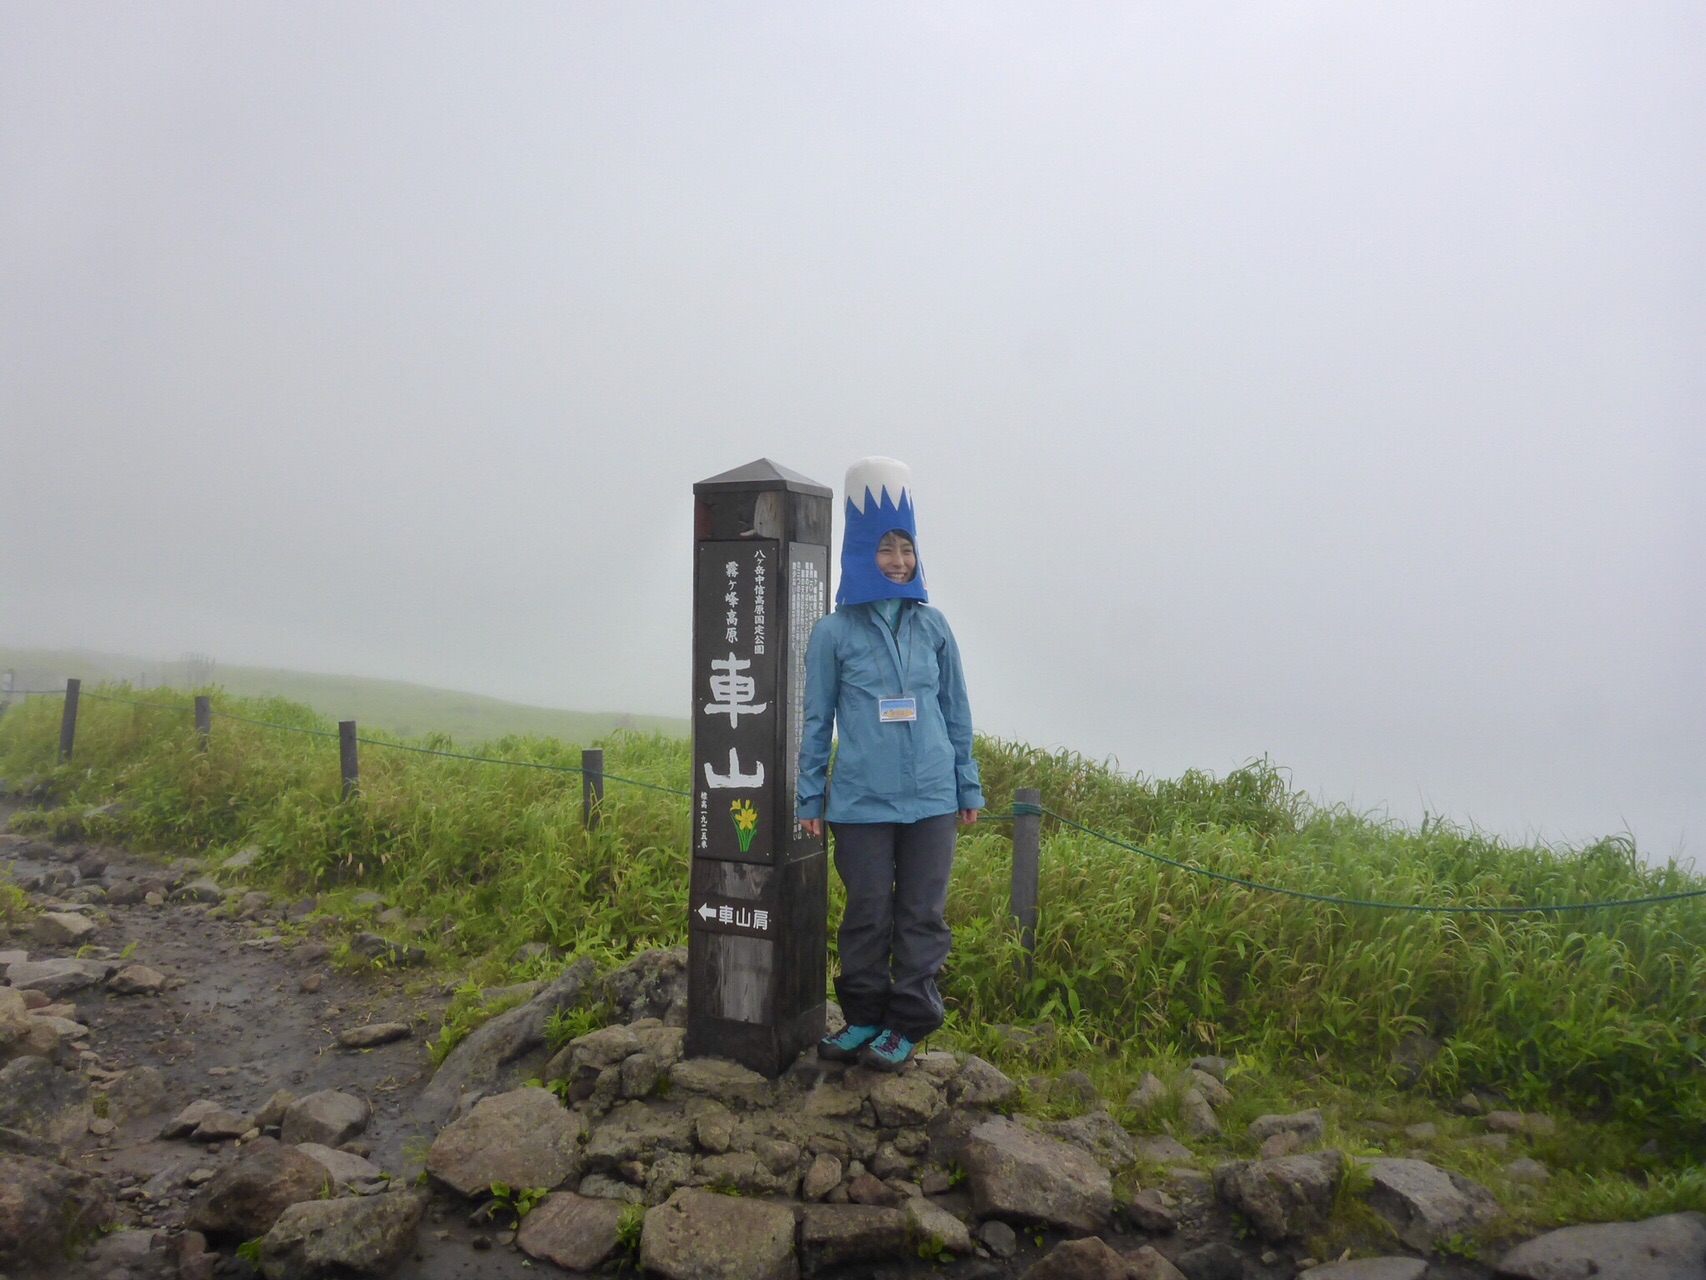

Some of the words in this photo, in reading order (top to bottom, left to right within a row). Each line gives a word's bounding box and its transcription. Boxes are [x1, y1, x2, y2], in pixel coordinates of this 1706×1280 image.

[704, 651, 767, 788] 車山
[719, 904, 768, 930] 車山肩
